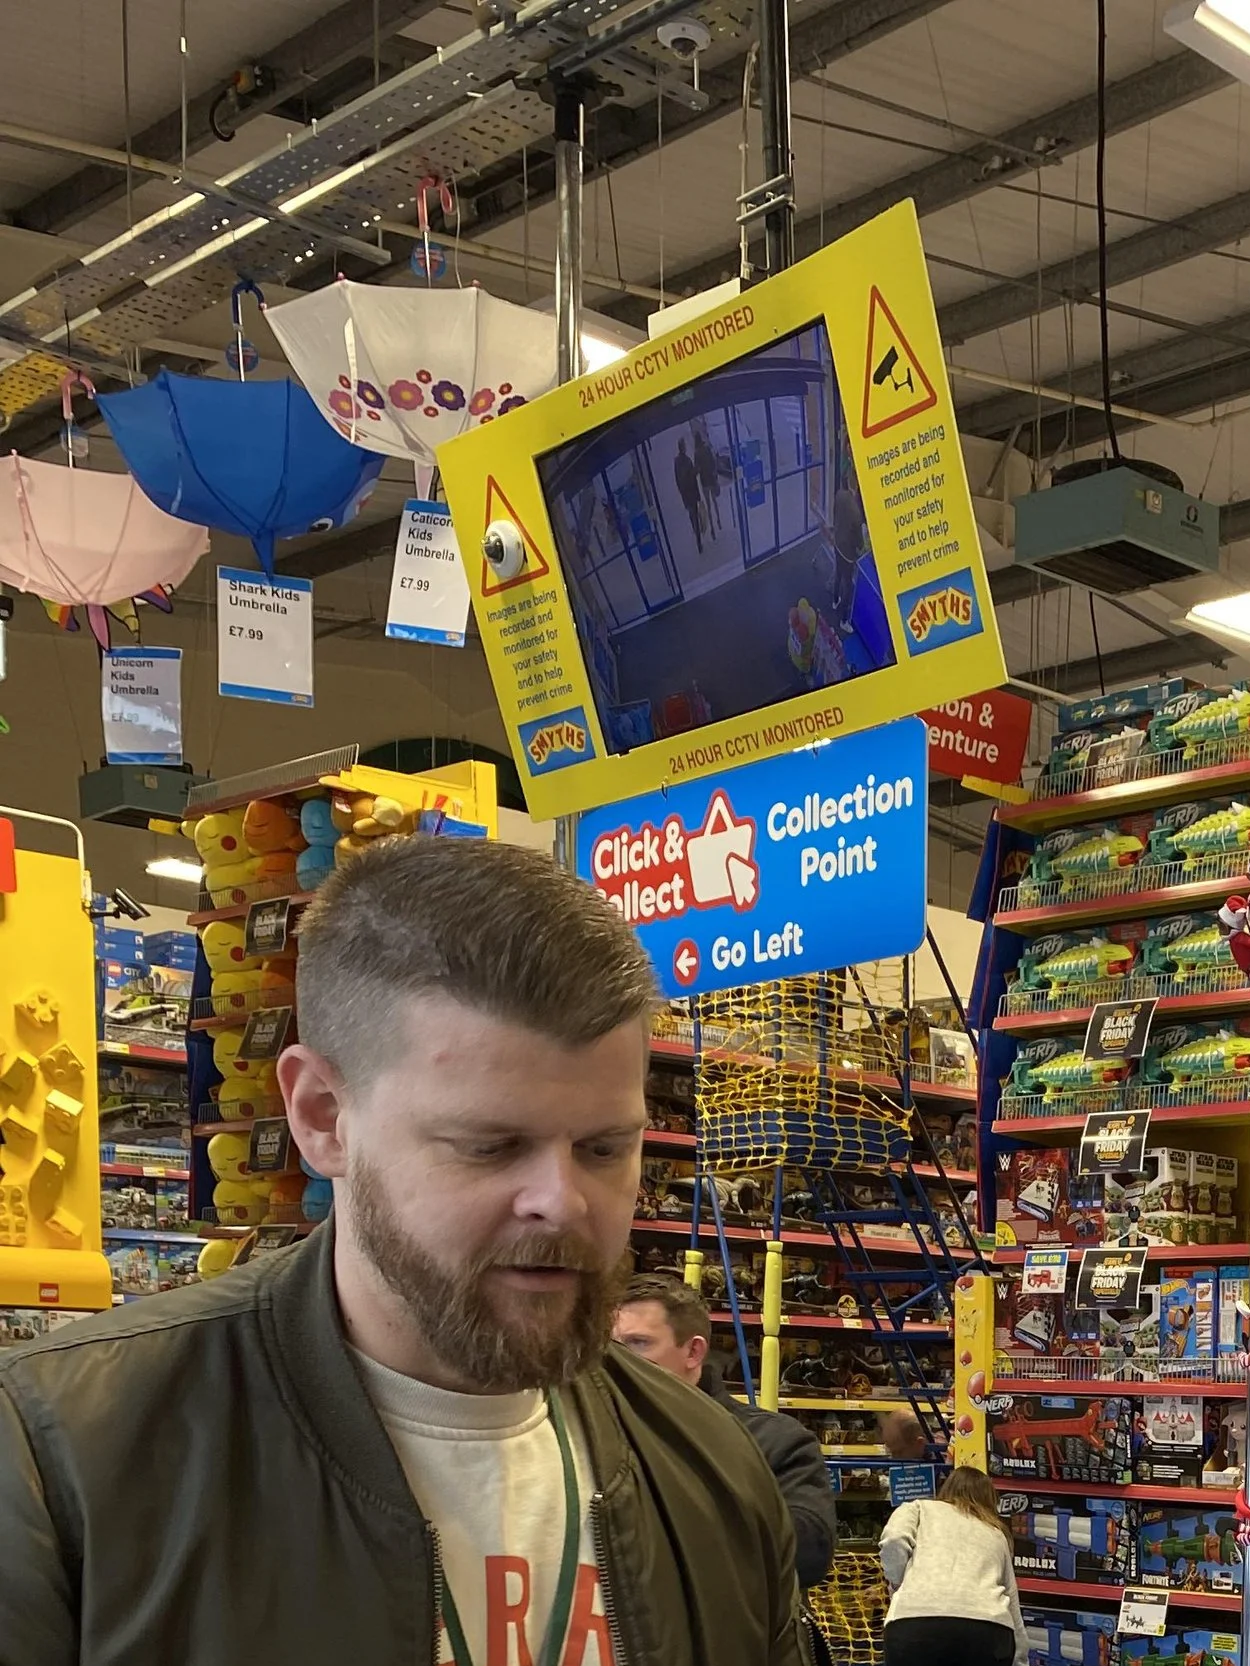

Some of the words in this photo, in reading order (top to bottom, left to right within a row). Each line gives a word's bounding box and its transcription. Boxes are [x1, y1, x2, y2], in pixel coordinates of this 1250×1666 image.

[579, 390, 595, 409] 24
[596, 367, 633, 401] HOUR
[634, 351, 670, 381] CCTV
[673, 305, 755, 362] MONITORED
[867, 449, 900, 470] Images
[902, 439, 916, 456] are
[918, 424, 945, 451] being
[880, 461, 920, 488] recorded
[922, 449, 940, 467] and
[884, 483, 930, 510] monitored
[931, 471, 945, 489] for
[893, 512, 913, 533] your
[916, 498, 944, 522] safety
[407, 527, 433, 542] Kids
[898, 533, 915, 551] and
[917, 529, 926, 545] to
[928, 519, 949, 541] help
[405, 544, 455, 562] Umbrella
[897, 553, 931, 577] prevent
[933, 539, 959, 561] crime
[229, 580, 267, 597] Shark
[271, 587, 300, 602] Kids
[400, 577, 430, 592] £7.99
[229, 596, 287, 615] Umbrella
[487, 605, 517, 622] Images
[518, 599, 532, 613] are
[533, 589, 558, 607] being
[909, 591, 971, 640] SMYTHS
[229, 625, 264, 641] £7.99
[499, 617, 536, 638] recorded
[537, 611, 554, 625] and
[503, 634, 545, 656] monitored
[546, 629, 558, 642] for
[111, 658, 154, 669] Unicorn
[512, 658, 531, 674] your
[533, 649, 558, 667] safety
[111, 671, 135, 681] Kids
[517, 676, 533, 690] and
[534, 674, 544, 685] to
[544, 666, 563, 681] help
[110, 684, 159, 696] Umbrella
[517, 691, 548, 711] prevent
[549, 683, 573, 698] crime
[979, 700, 995, 729] &
[529, 722, 585, 763] SMYTHS
[669, 757, 685, 774] 24
[686, 746, 724, 770] HOUR
[726, 733, 760, 758] CCTV
[763, 708, 844, 747] MONITORED
[929, 724, 999, 764] enture
[767, 774, 914, 842] Collection
[595, 827, 660, 880] Click
[664, 815, 684, 860] &
[800, 836, 877, 887] Point
[600, 873, 685, 922] ollect
[711, 935, 745, 971] Go
[754, 922, 803, 964] Left
[1101, 1027, 1135, 1040] FRIDAY
[1104, 1015, 1136, 1028] BLACK
[1095, 1140, 1130, 1153] FRIDAY
[1091, 1276, 1125, 1289] FRIDAY
[1003, 1457, 1036, 1469] ROBLOX
[1014, 1556, 1056, 1570] ROBLOX
